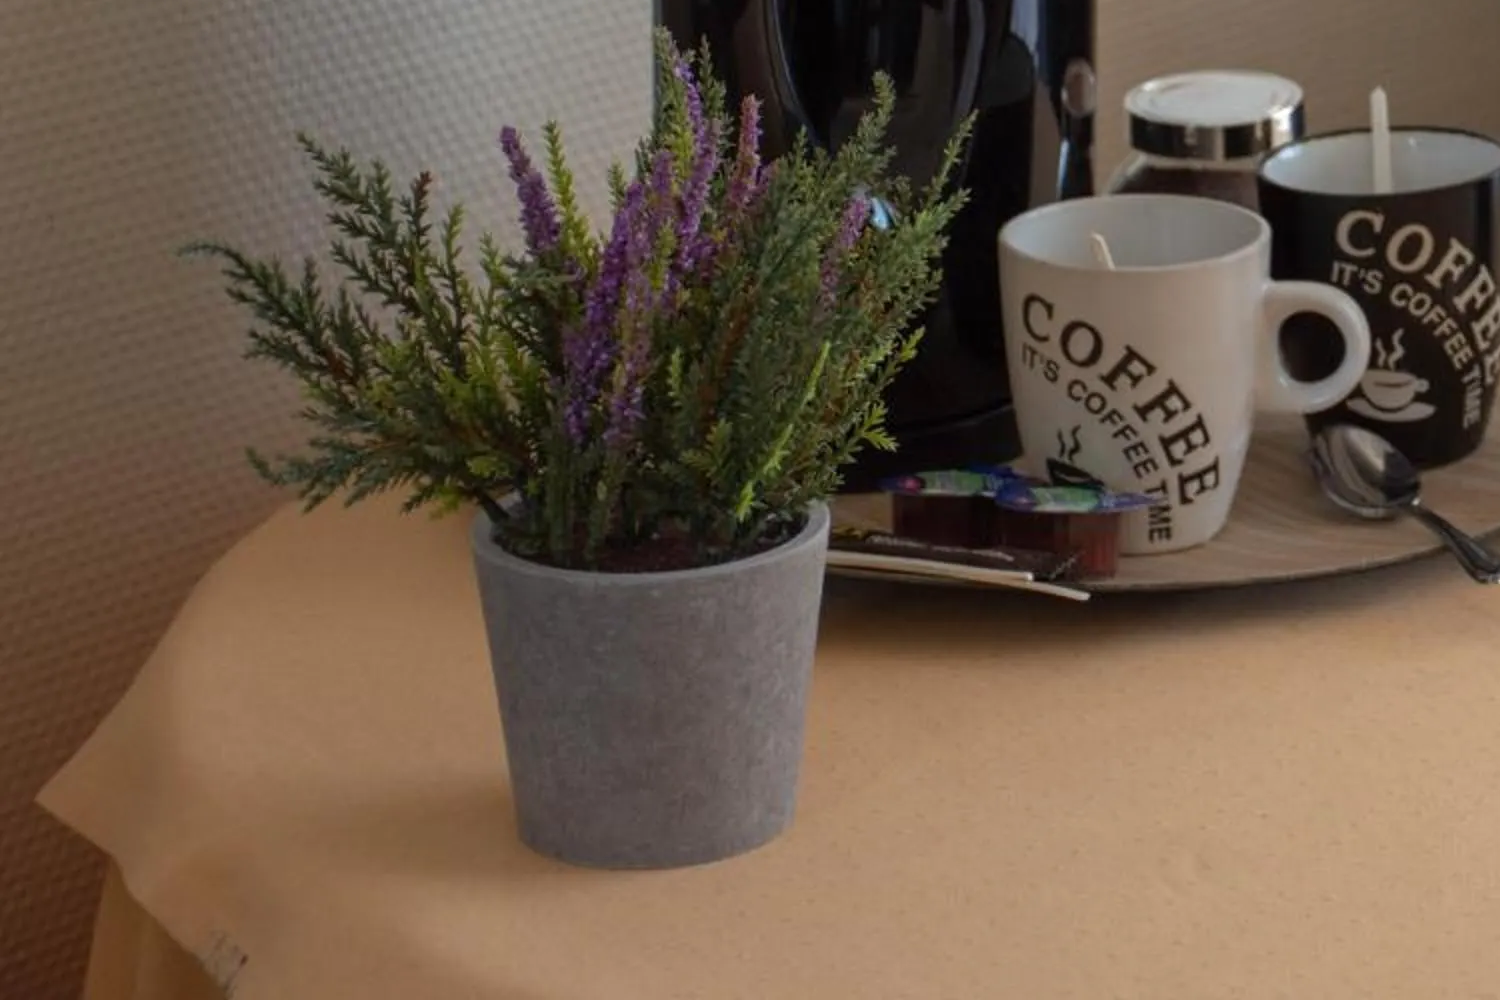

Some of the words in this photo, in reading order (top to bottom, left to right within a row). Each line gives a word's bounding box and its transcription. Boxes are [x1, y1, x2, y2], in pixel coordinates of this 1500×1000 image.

[1022, 293, 1219, 506] COFFEE
[1330, 260, 1383, 295] IT'S
[1389, 283, 1474, 369] COFFEE
[1021, 343, 1060, 383] IT'S
[1067, 378, 1159, 479] COFFEE
[1145, 477, 1173, 544] TME
